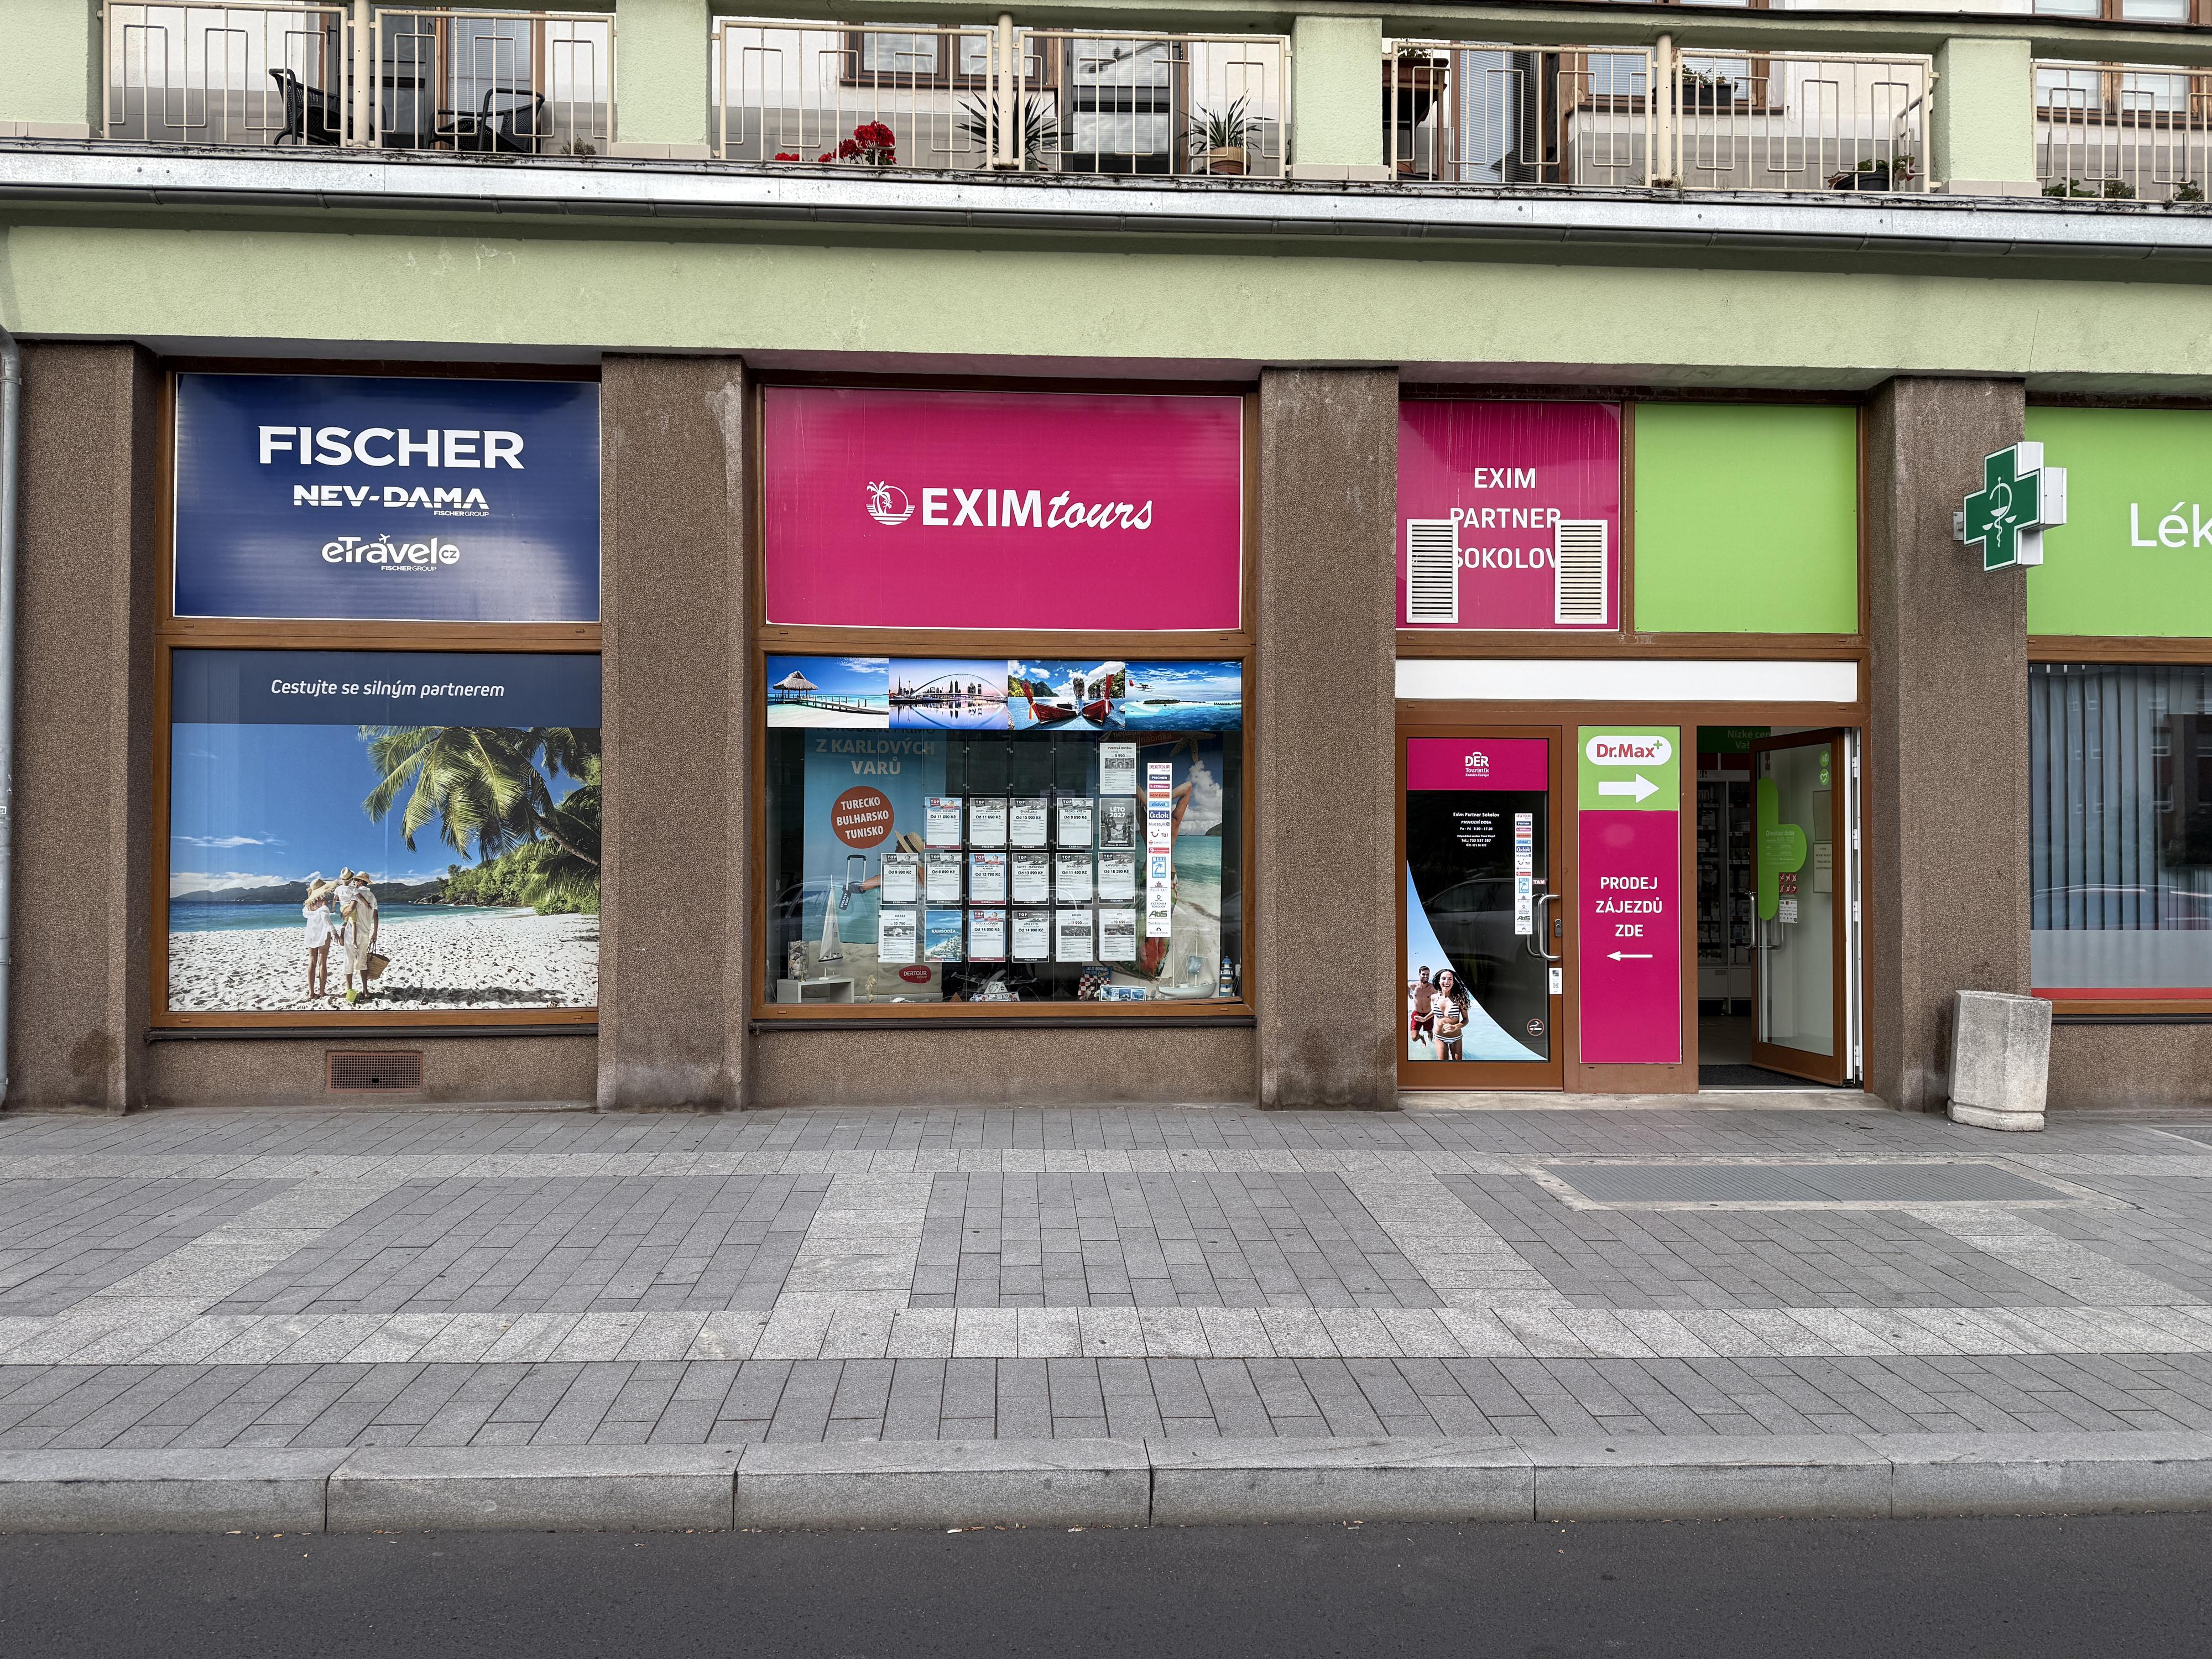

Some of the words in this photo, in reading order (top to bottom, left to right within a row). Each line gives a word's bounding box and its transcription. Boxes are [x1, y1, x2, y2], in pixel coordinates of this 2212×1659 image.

[258, 426, 525, 469] FISCHER
[1474, 467, 1537, 489] EXIM
[294, 485, 489, 510] NEV-DAMA
[1450, 508, 1562, 529] PARTNER
[2131, 502, 2212, 548] Lék
[271, 679, 337, 696] Cestujte
[341, 682, 359, 696] se
[363, 680, 416, 699] silným
[420, 681, 505, 700] partnerem
[1727, 730, 1753, 738] Nízké
[816, 739, 827, 753] Z
[831, 737, 935, 755] KARLOVÝCH
[851, 756, 901, 775] VARŮ
[840, 796, 880, 811] TURECKO
[836, 810, 890, 827] BULHARSKO
[845, 825, 884, 839] TUNISKO
[1600, 876, 1658, 891] PRODEJ
[1595, 896, 1663, 914] ZÁJEZDŮ
[1615, 924, 1644, 938] ZDE
